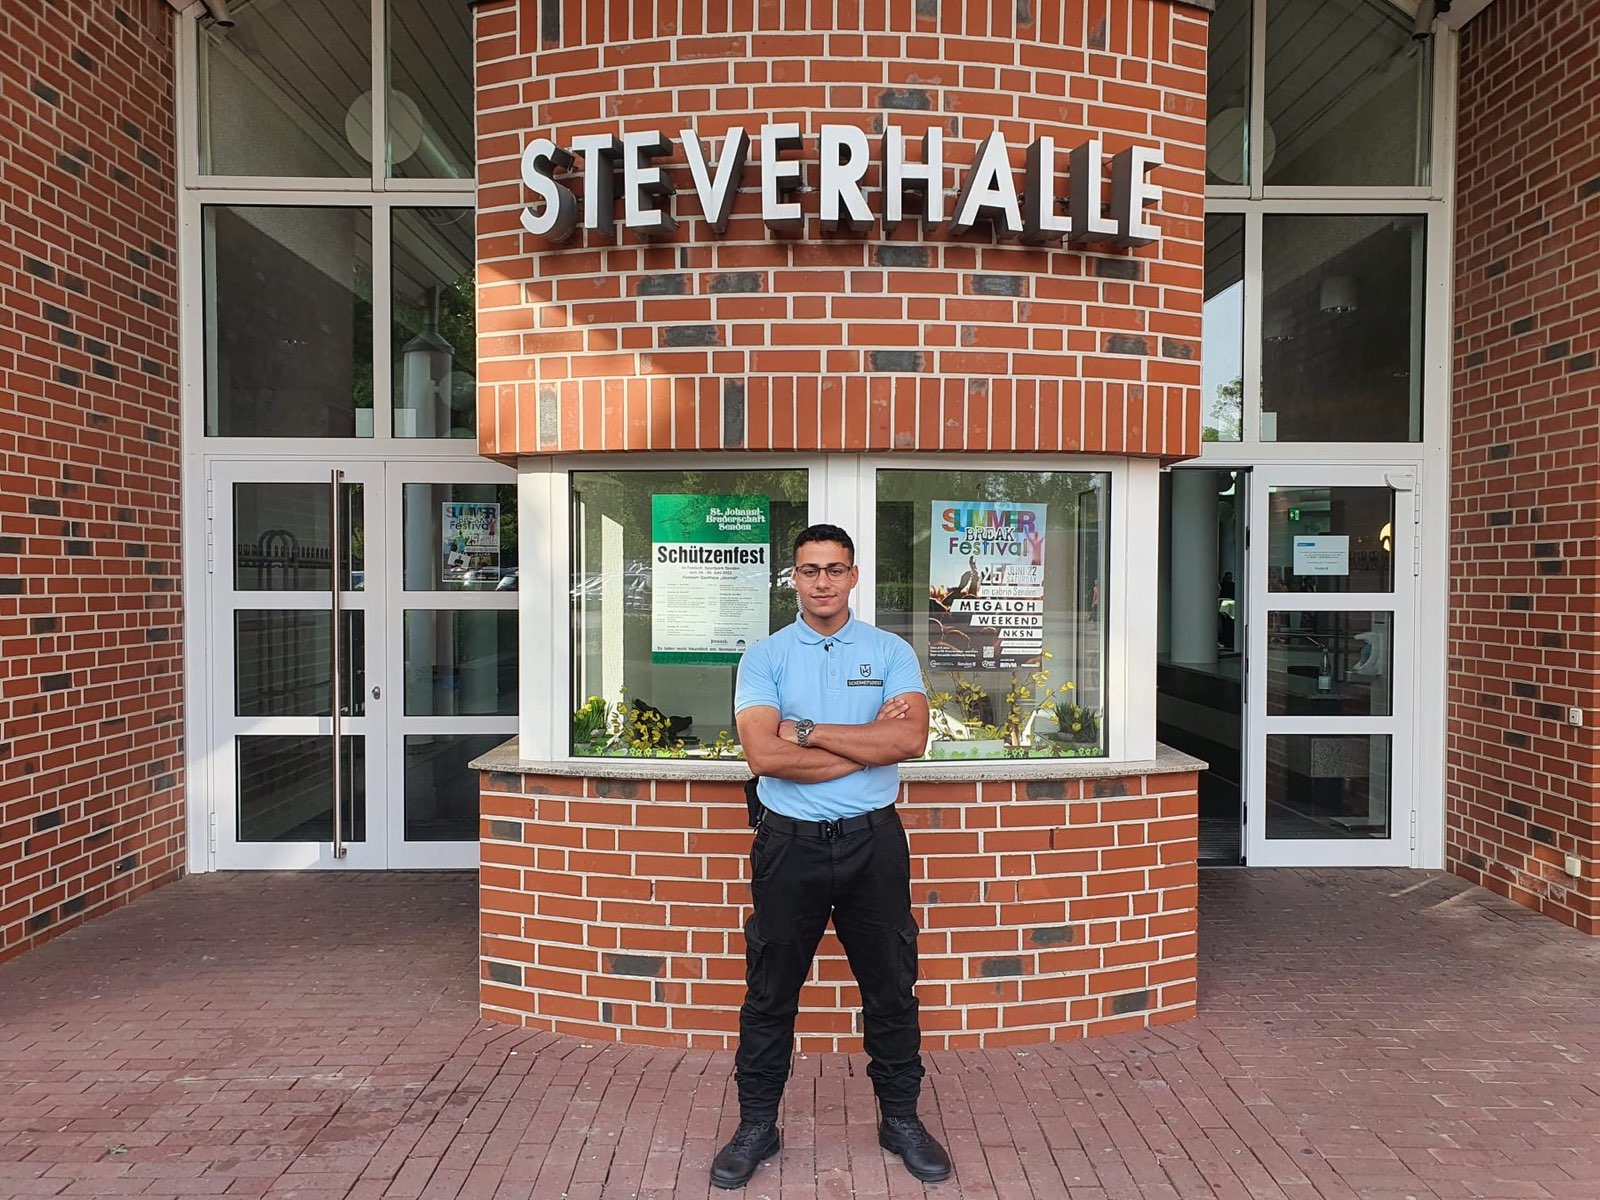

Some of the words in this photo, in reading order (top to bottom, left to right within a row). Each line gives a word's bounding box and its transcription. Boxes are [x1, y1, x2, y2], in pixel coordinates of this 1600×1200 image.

[519, 122, 1165, 241] STEVERHALLE
[706, 515, 766, 523] Bruderschaft
[942, 508, 1036, 533] SUMMER
[718, 523, 751, 531] Senden
[965, 527, 1015, 542] BREAK
[949, 537, 1028, 556] Festival
[657, 545, 765, 564] Schützenfest
[981, 587, 989, 595] im
[991, 587, 1012, 596] cabrio
[1013, 587, 1036, 596] Senden
[959, 601, 1035, 612] MEGALOH
[979, 616, 1038, 625] WEEKEND
[1003, 630, 1033, 638] NKSN
